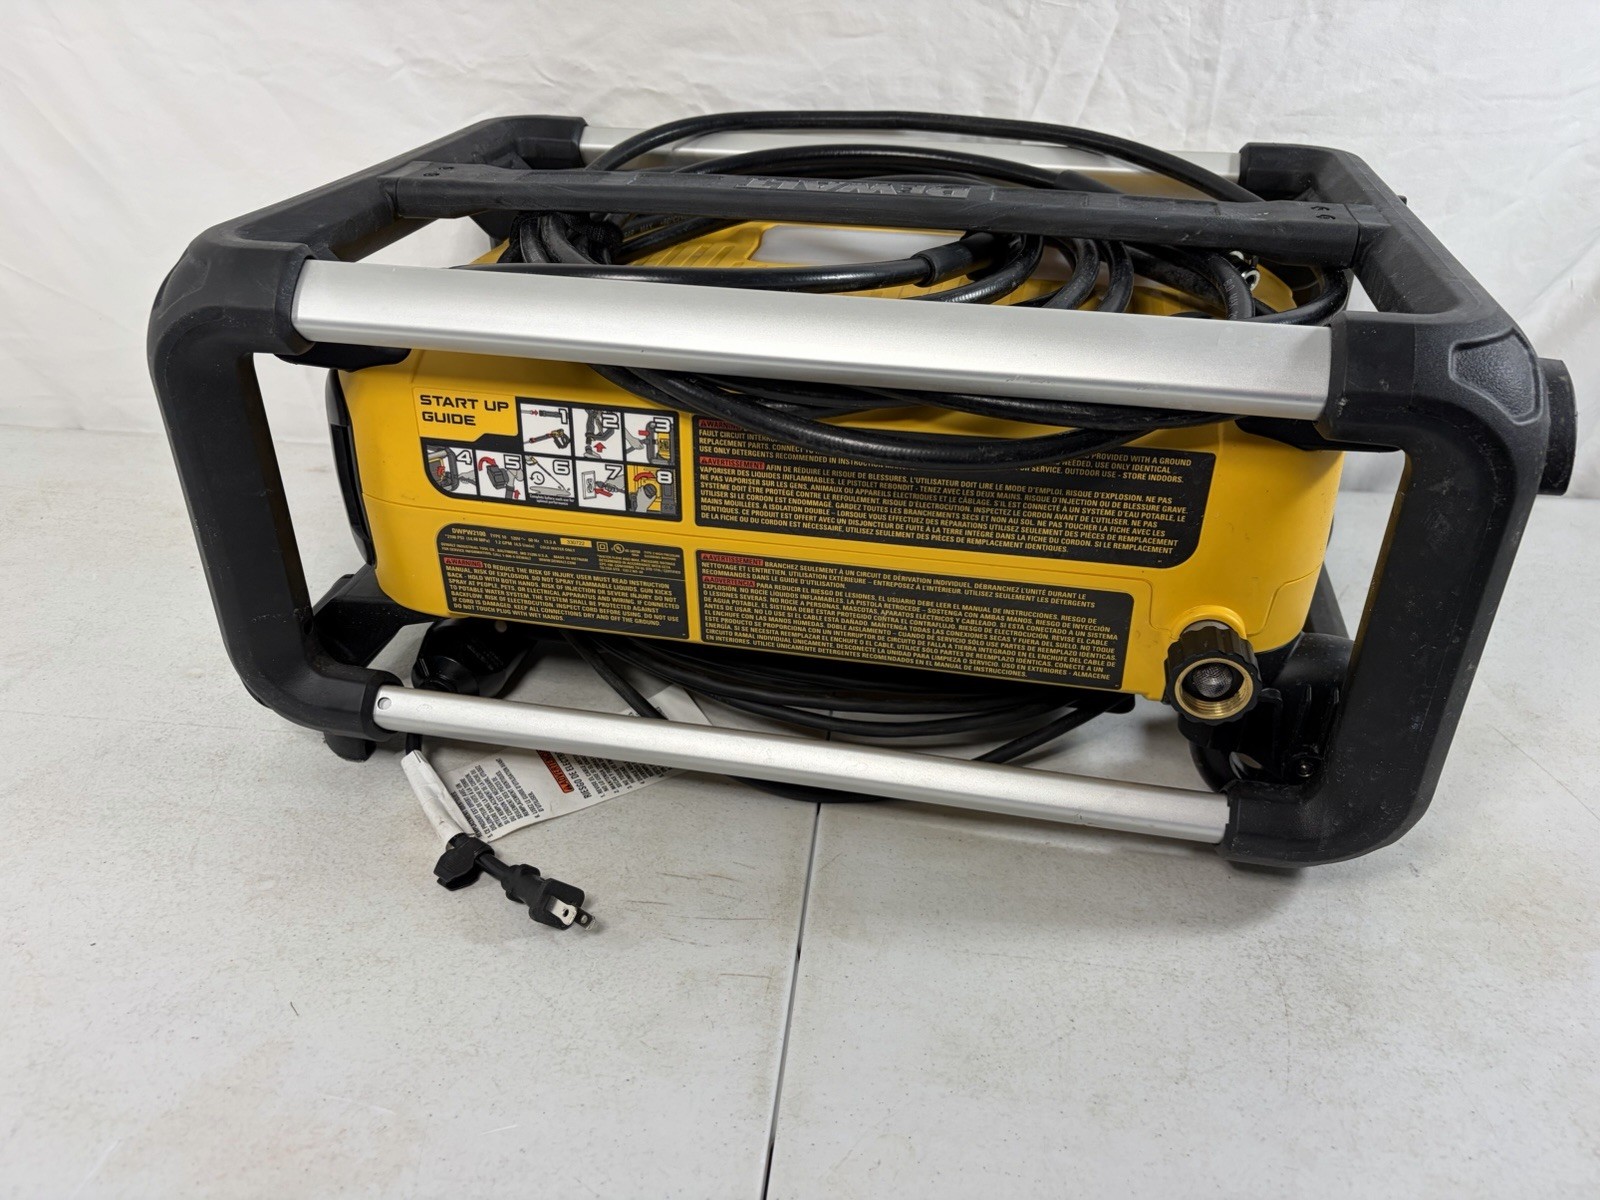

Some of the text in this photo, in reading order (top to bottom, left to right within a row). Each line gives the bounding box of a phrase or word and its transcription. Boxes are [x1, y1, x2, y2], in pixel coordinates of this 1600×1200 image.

[736, 178, 971, 198] DEWALT
[420, 394, 509, 412] START UP
[422, 412, 476, 426] GUIDE
[559, 408, 570, 424] 1
[602, 412, 620, 429] 2
[654, 417, 672, 433] 3
[698, 429, 718, 437] FAULT
[719, 430, 744, 439] CIRCUIT
[698, 437, 745, 447] REPLACEMENT
[456, 450, 472, 465] 4
[713, 446, 729, 454] ONLY
[731, 448, 773, 458] DETERGENTS
[775, 451, 827, 462] RECOMMENDED
[1129, 454, 1150, 463] WITH
[1158, 457, 1192, 466] GROUND
[504, 455, 521, 470] 5
[552, 460, 570, 475] 6
[1131, 464, 1171, 473] IDENTICAL
[605, 464, 622, 479] 7
[656, 469, 673, 484] 8
[1064, 467, 1100, 476] OUTDOOR
[1122, 472, 1146, 480] STORE
[708, 458, 763, 469] AVERTISSEMENT
[766, 464, 781, 472] AFIN
[831, 469, 855, 478] RISQUE
[909, 476, 959, 486] L'UTILISATEUR
[960, 480, 976, 488] DOIT
[978, 481, 993, 489] LIRE
[1004, 483, 1026, 492] MODE
[1065, 488, 1092, 497] RISQUE
[1157, 496, 1172, 504] PAS
[699, 467, 735, 476] VAPORISER
[750, 471, 780, 480] LIQUIDES
[846, 479, 877, 488] PISTOLET
[879, 481, 913, 491] REBONDIT
[920, 485, 941, 493] TENEZ
[942, 486, 960, 495] AVEC
[975, 489, 994, 498] DEUX
[1024, 493, 1050, 502] RISQUE
[1051, 495, 1097, 506] D'INJECTION
[1122, 501, 1160, 511] BLESSURE
